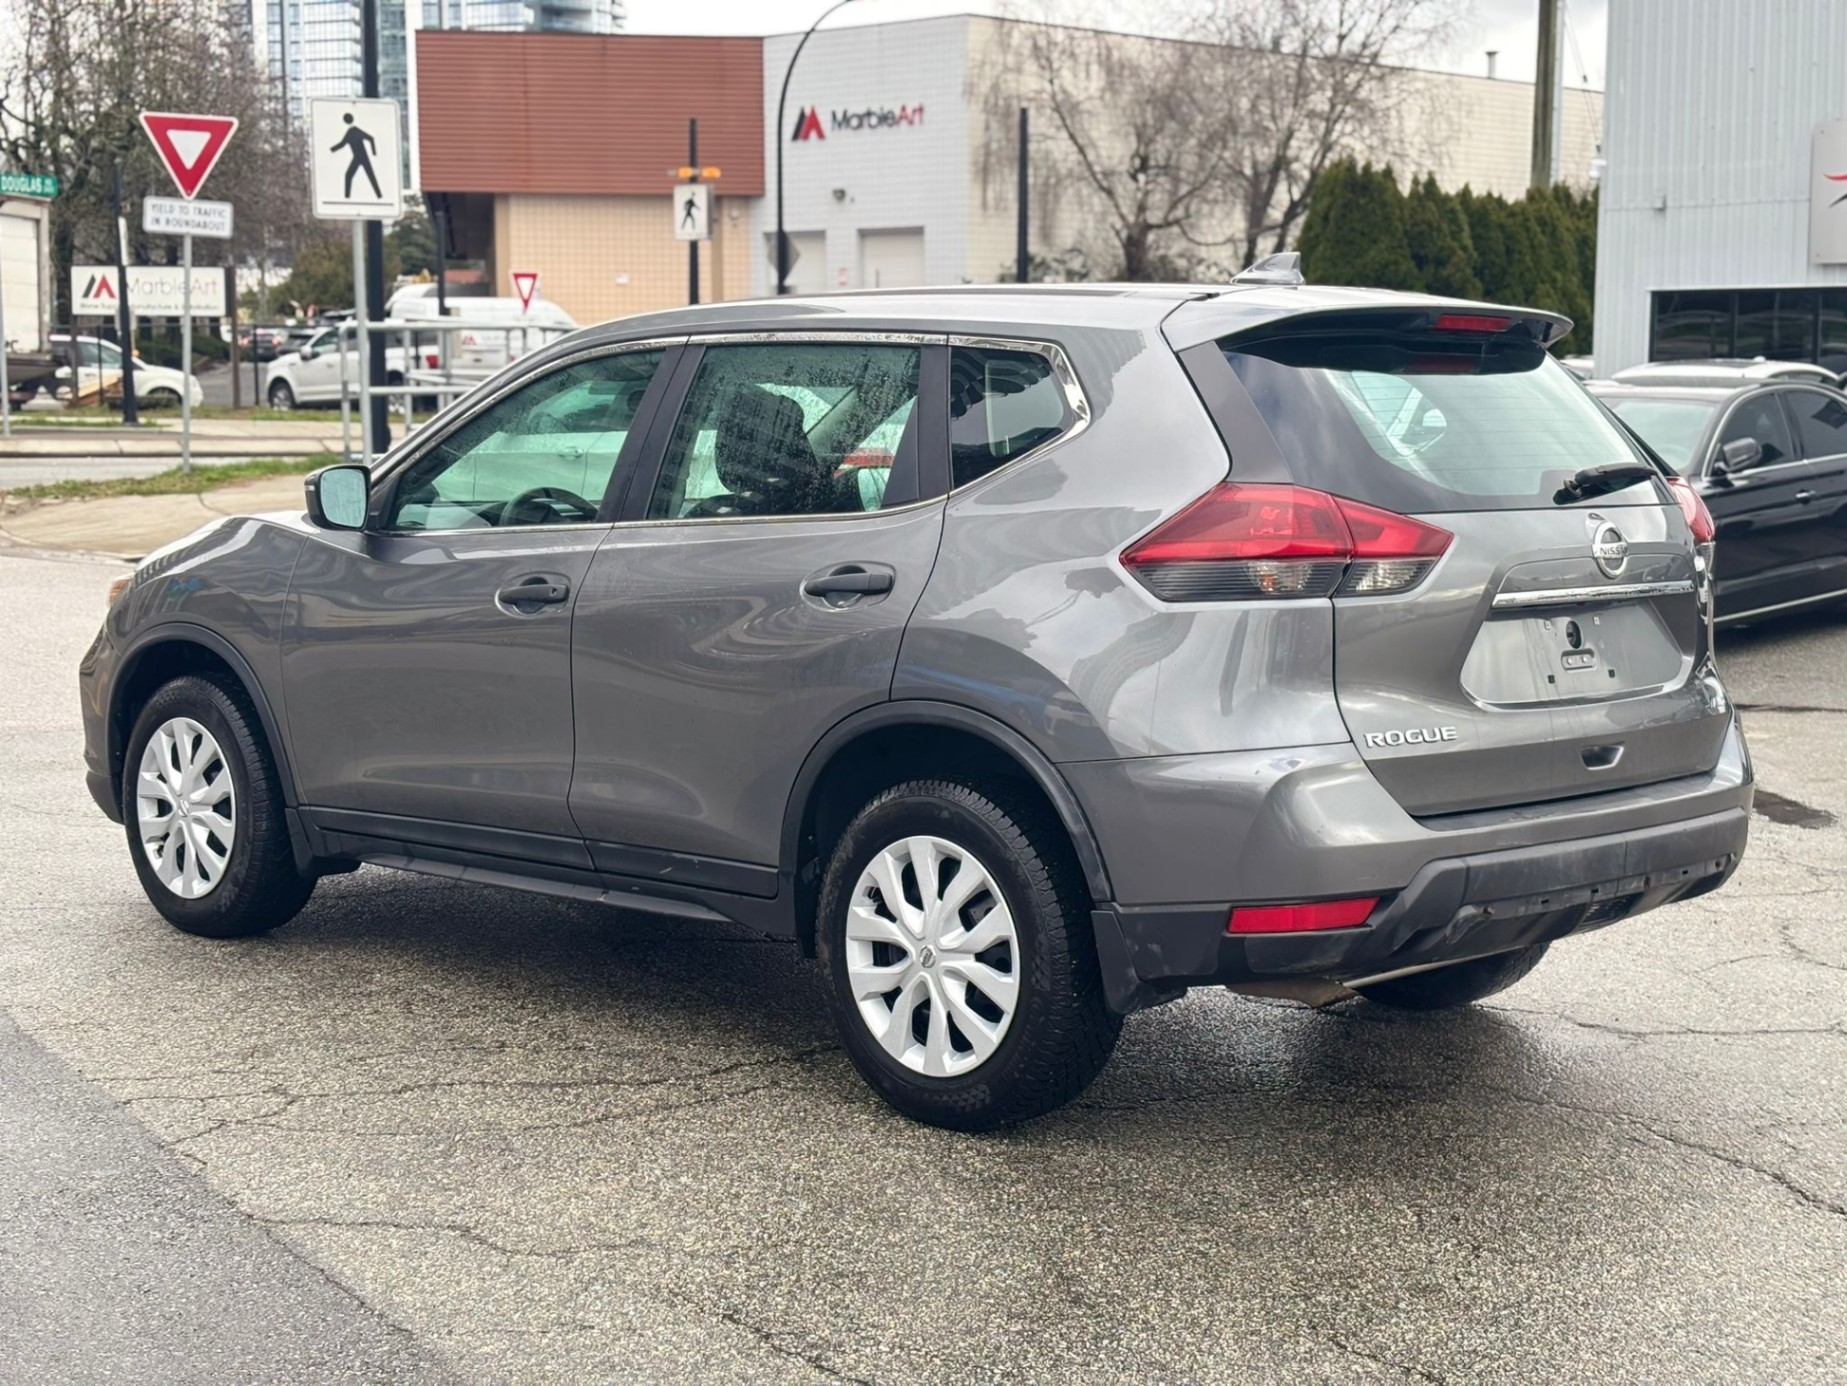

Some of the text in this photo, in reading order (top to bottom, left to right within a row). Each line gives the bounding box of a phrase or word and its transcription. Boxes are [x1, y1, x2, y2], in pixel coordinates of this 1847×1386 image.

[831, 103, 924, 131] MarbleArt
[1, 175, 42, 193] DOUGLAS
[151, 203, 226, 219] YIELD TO TRAFFIC
[151, 217, 226, 231] IN ROUNDABOUT
[1364, 726, 1458, 748] ROGUE
